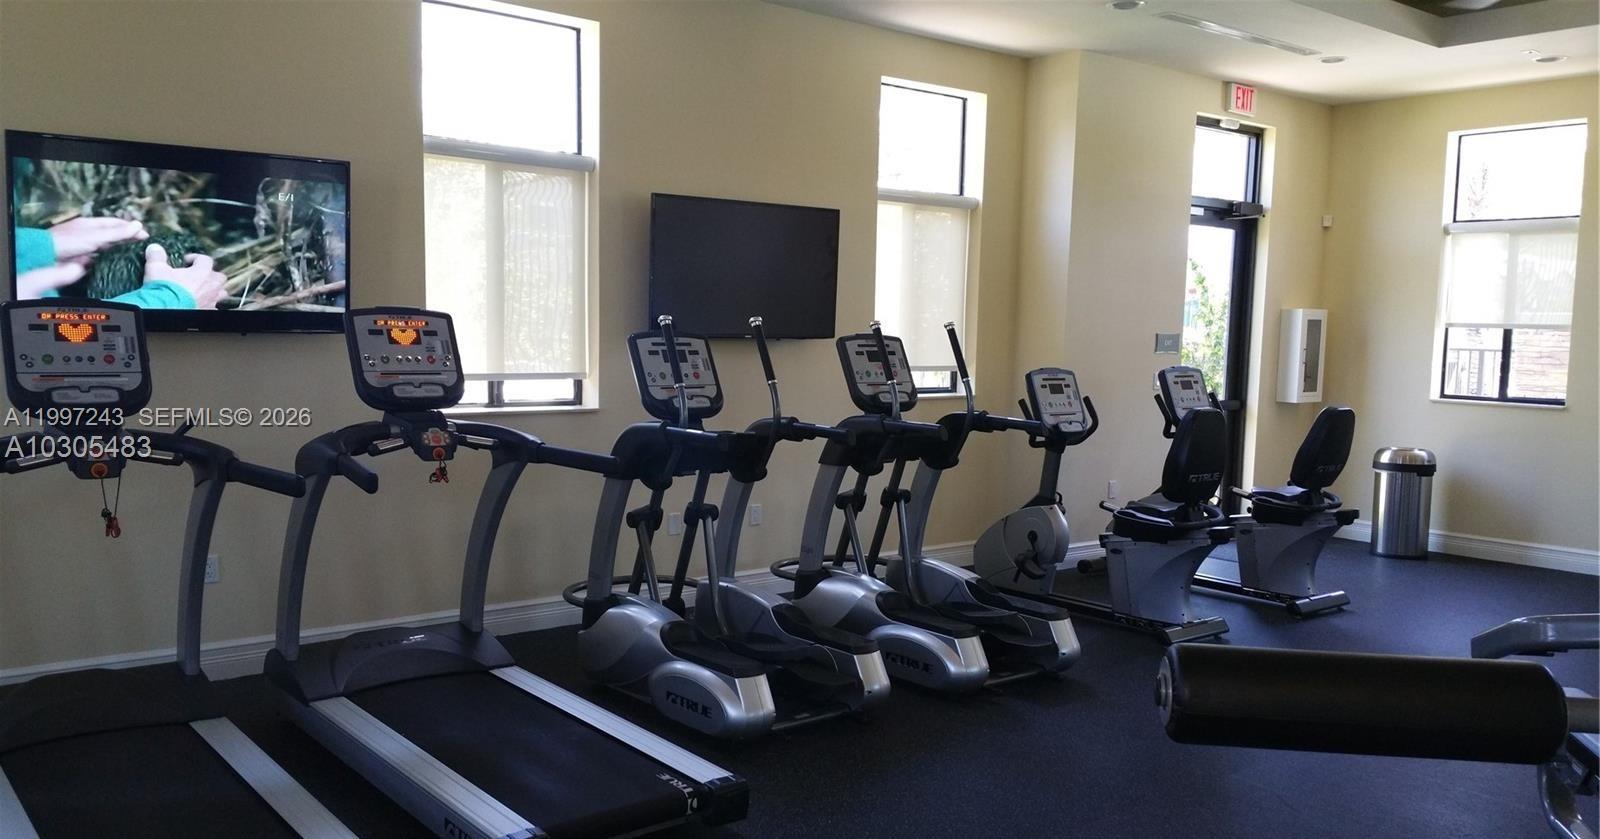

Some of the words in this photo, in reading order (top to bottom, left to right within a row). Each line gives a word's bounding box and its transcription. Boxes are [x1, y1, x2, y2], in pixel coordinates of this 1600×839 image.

[1235, 86, 1255, 112] EXIT
[55, 312, 79, 320] PRESS
[82, 313, 106, 321] ENTER
[679, 694, 713, 719] TRUE
[656, 771, 694, 798] TRUE
